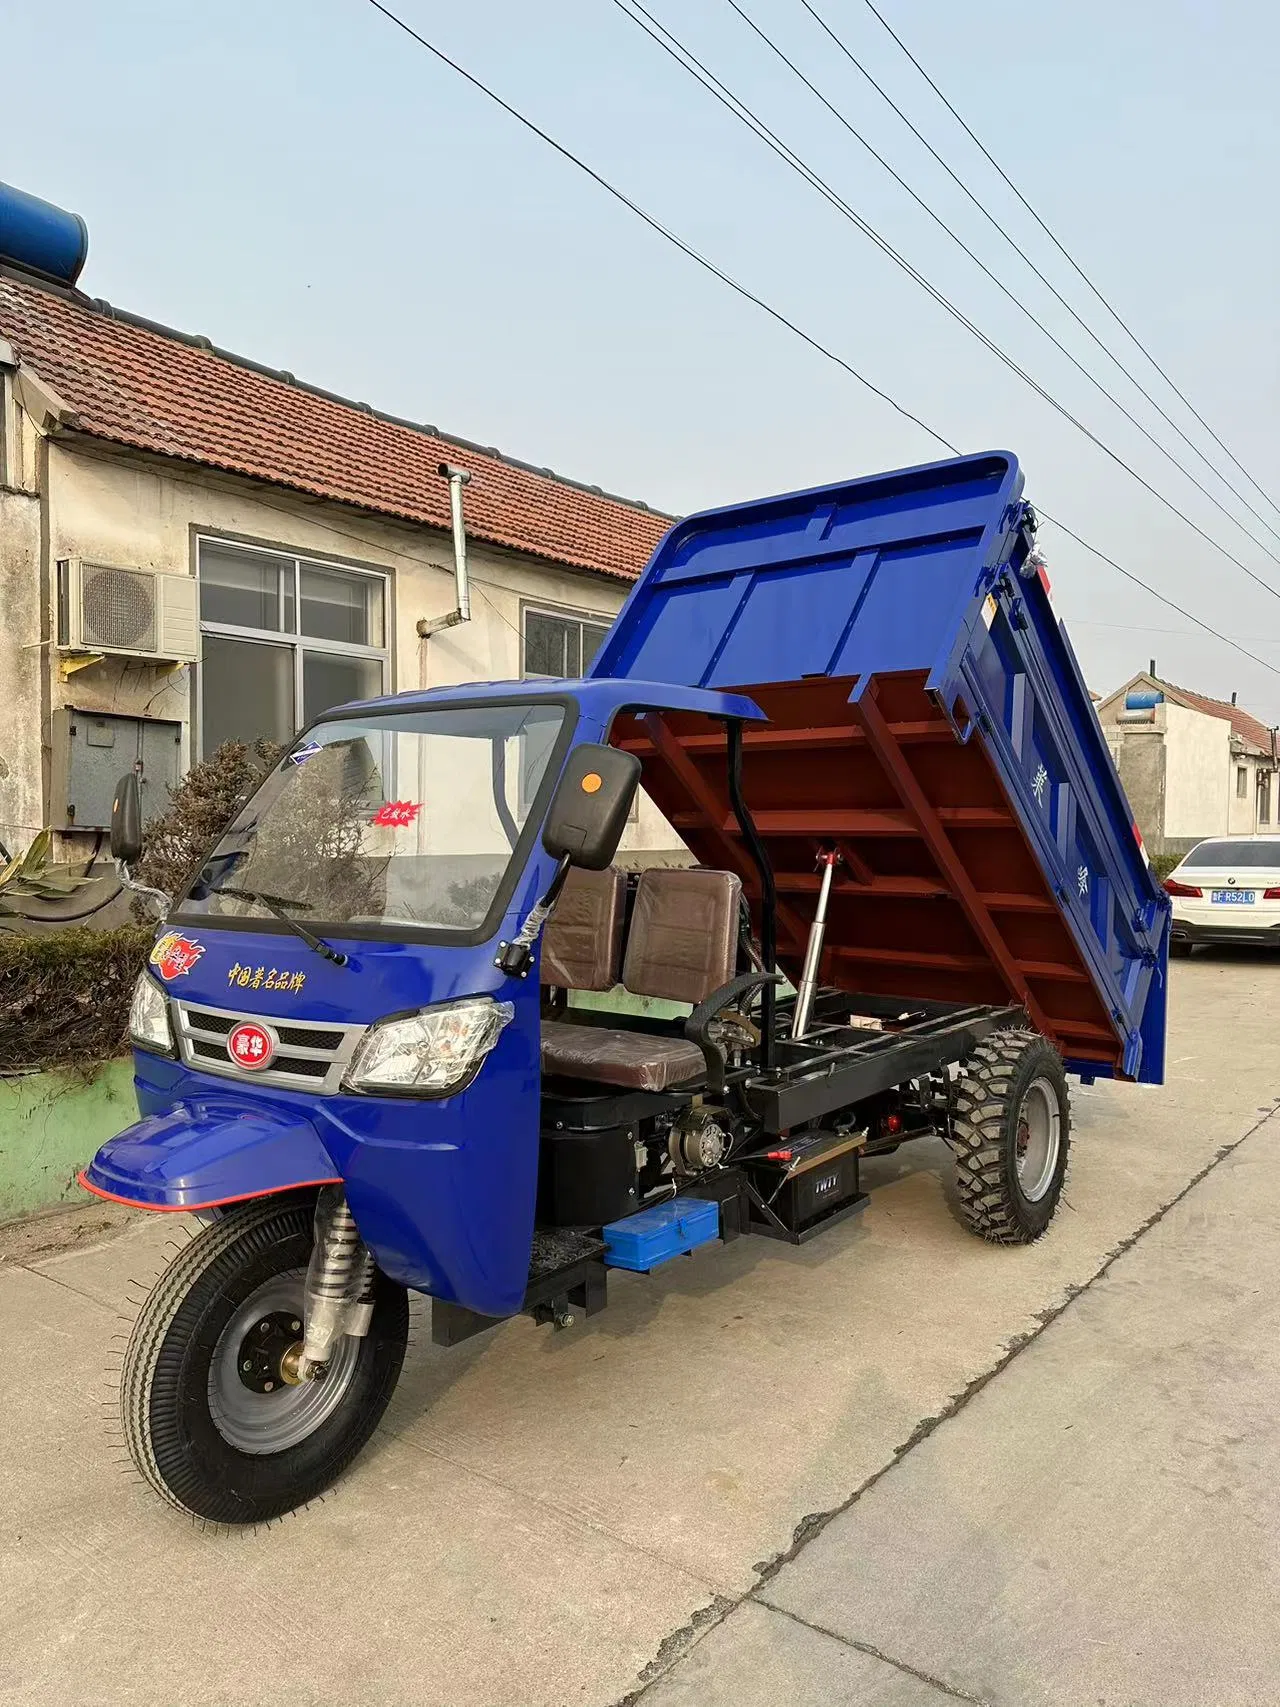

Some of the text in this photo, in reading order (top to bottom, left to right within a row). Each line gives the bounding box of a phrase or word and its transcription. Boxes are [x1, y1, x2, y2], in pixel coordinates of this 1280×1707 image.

[228, 962, 306, 995] 中国著名品牌
[236, 1033, 263, 1057] 豪华
